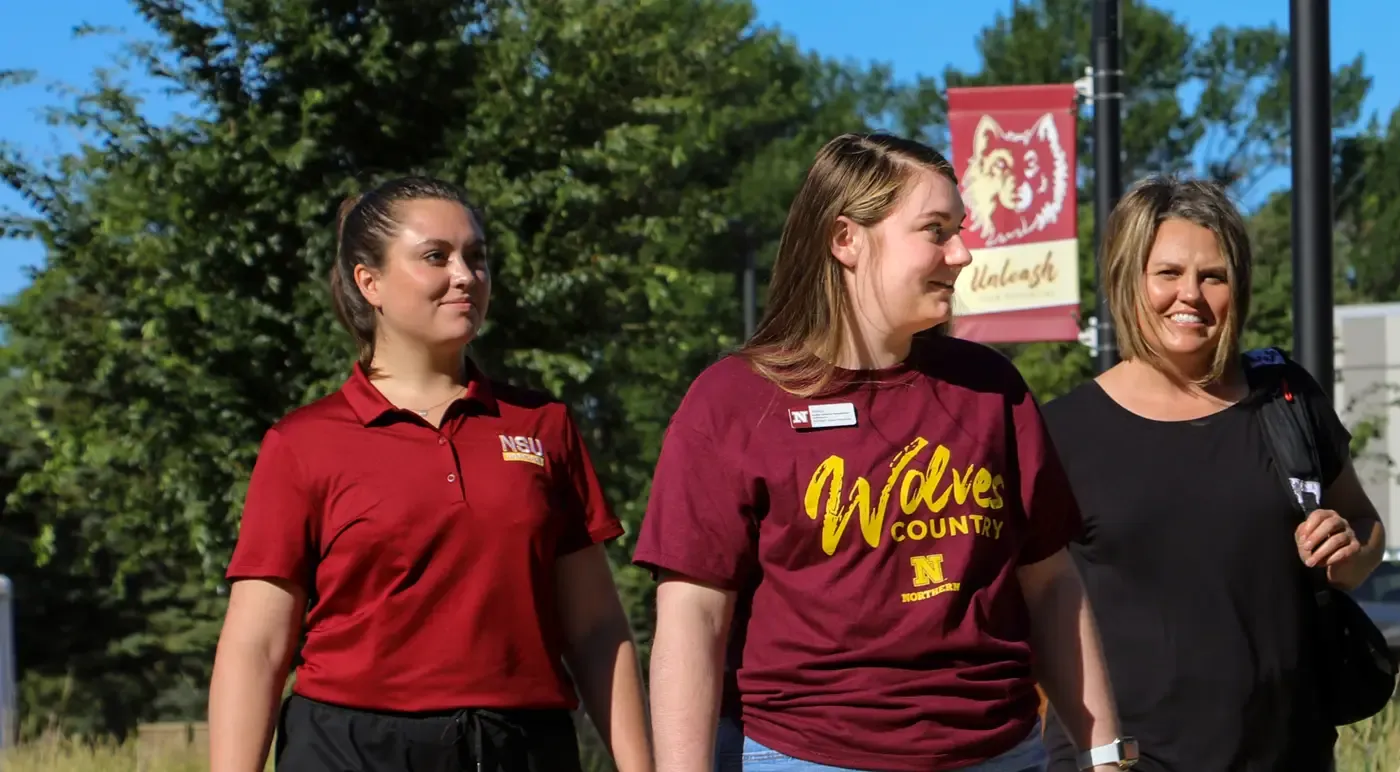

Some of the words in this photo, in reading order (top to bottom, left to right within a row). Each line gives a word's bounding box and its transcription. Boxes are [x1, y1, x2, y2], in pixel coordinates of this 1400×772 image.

[970, 250, 1057, 292] Unleash
[791, 410, 808, 424] N
[499, 434, 543, 456] NSU
[804, 437, 1005, 556] Wolves
[891, 514, 1004, 542] COUNTRY
[910, 554, 945, 587] N
[901, 582, 961, 603] NORTHERN
